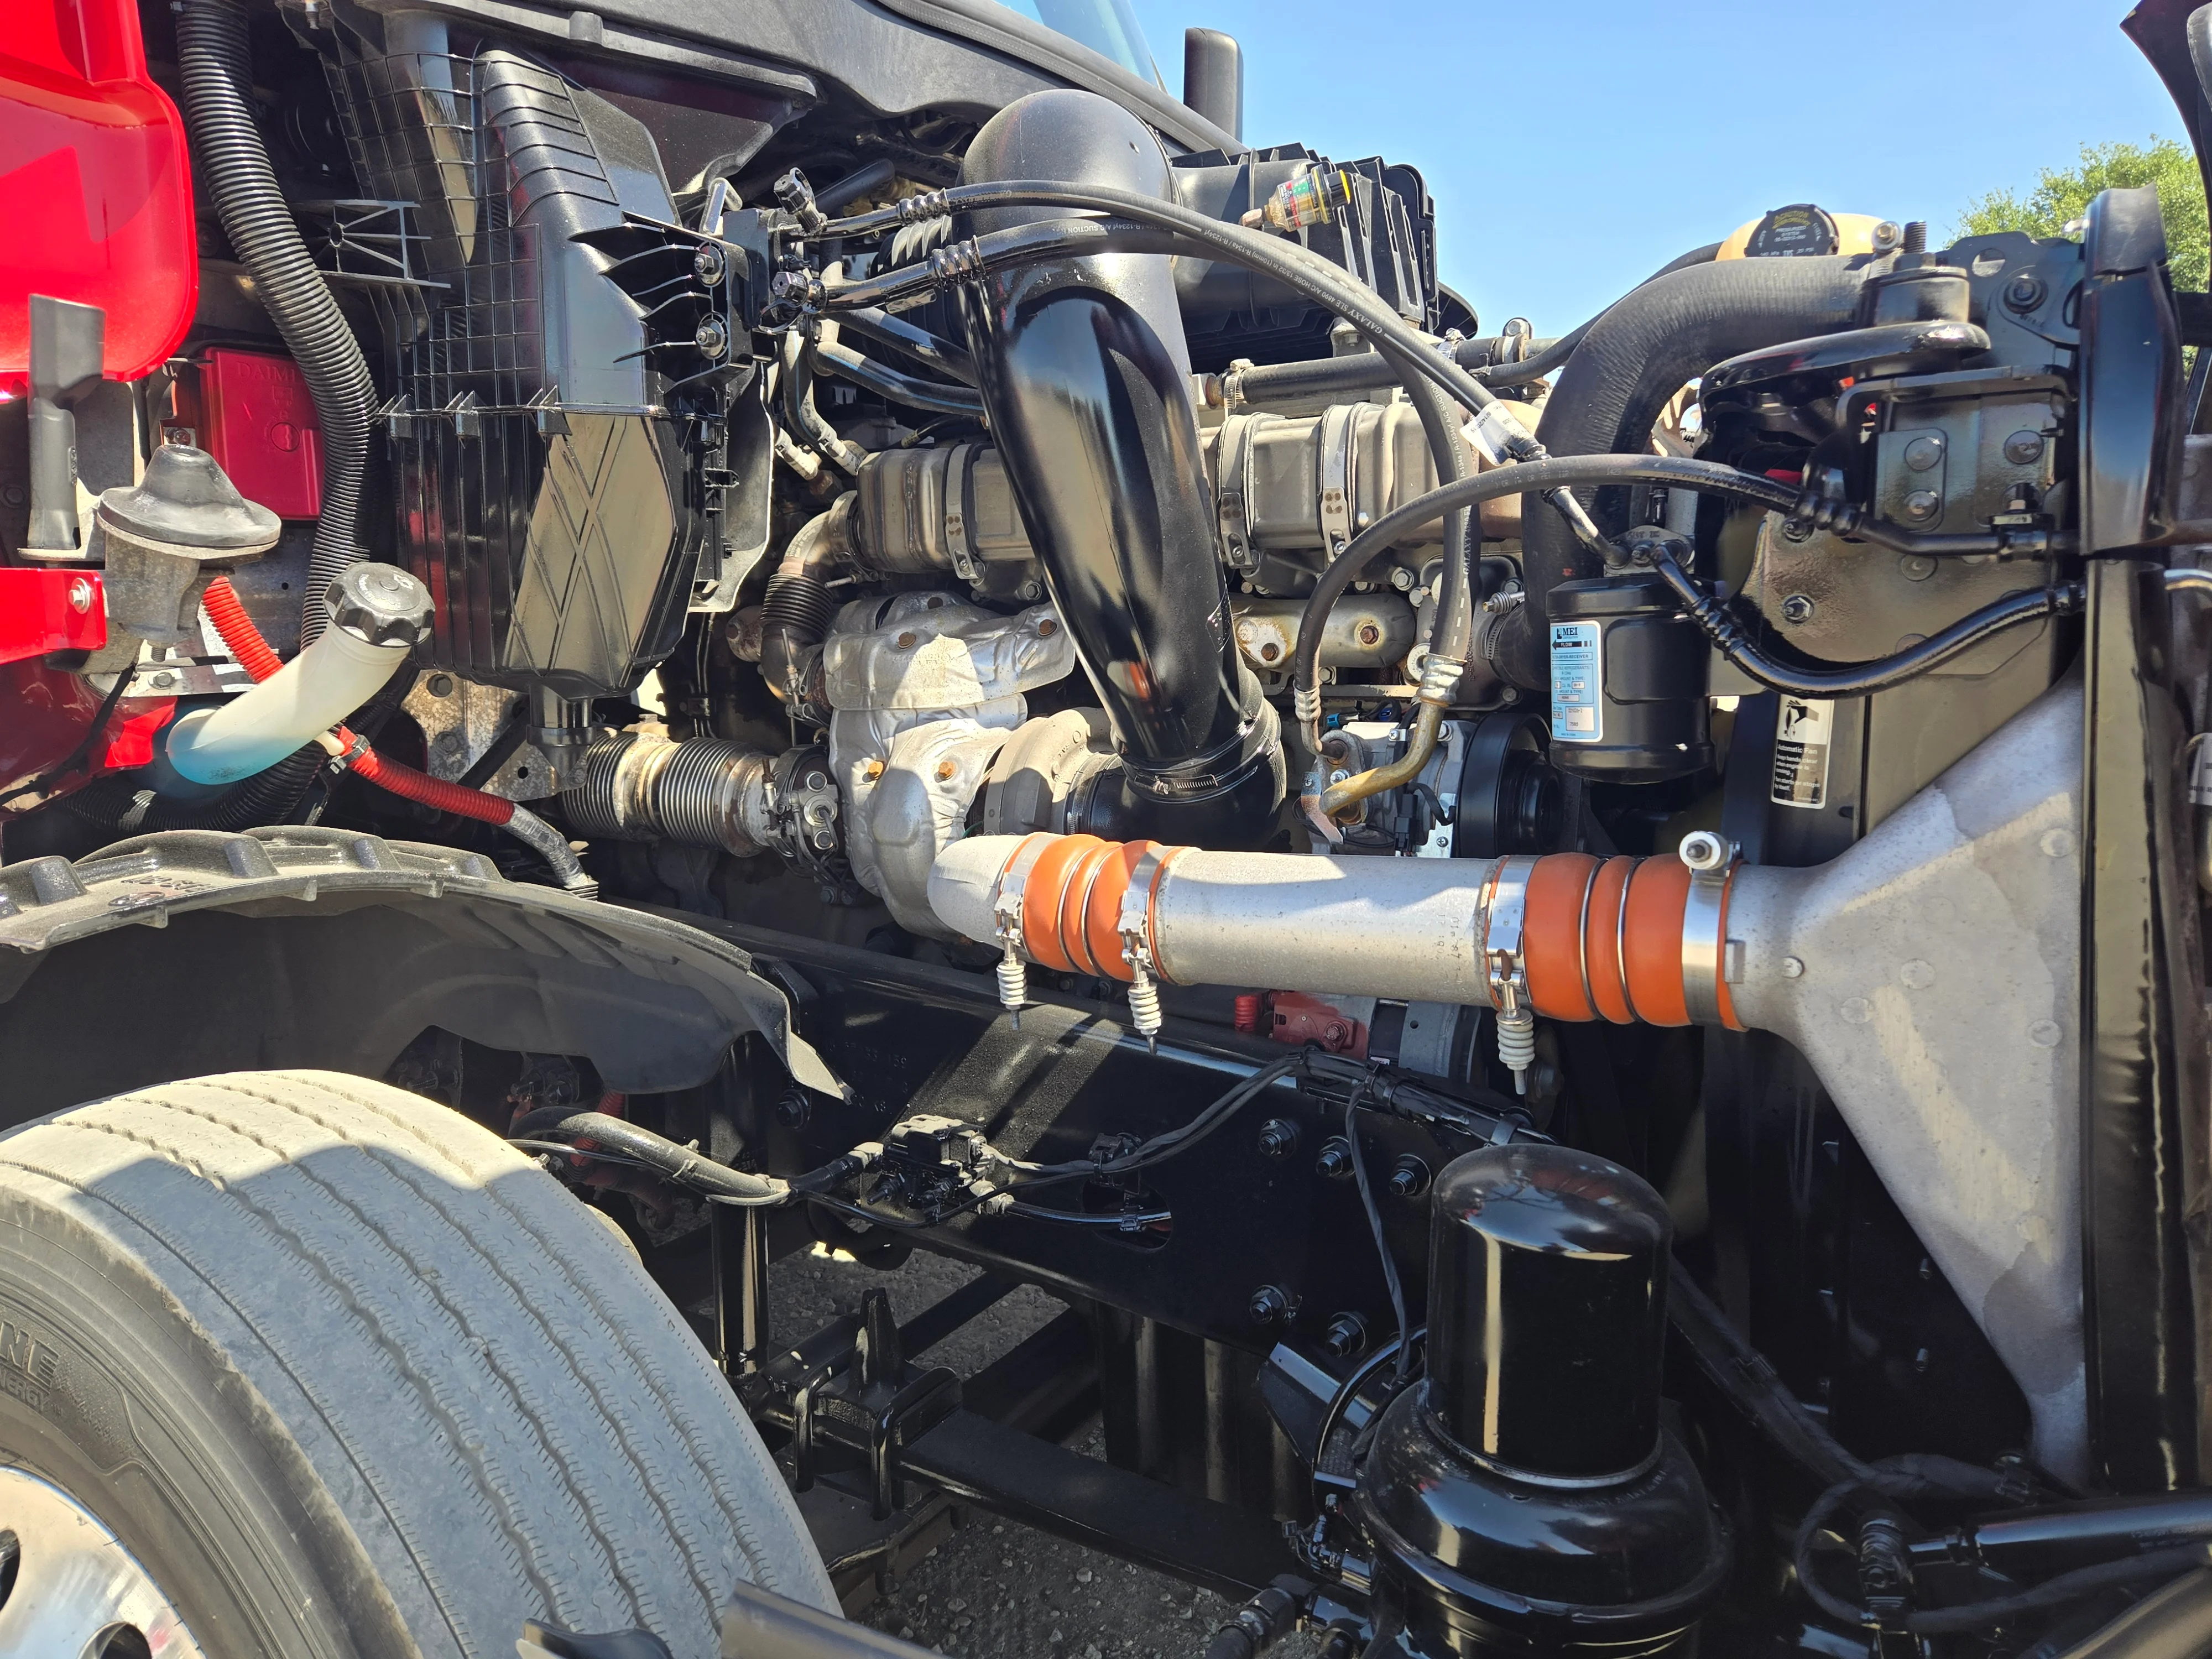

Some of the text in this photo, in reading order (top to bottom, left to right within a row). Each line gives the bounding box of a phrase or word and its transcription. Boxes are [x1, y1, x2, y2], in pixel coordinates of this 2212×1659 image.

[1068, 225, 1099, 234] SUCTION
[1232, 242, 1251, 255] R-134a
[1252, 251, 1272, 266] (10mm)
[1279, 266, 1293, 278] 13/32
[1294, 274, 1311, 288] HOSE
[1311, 284, 1322, 294] A/C
[1321, 291, 1335, 302] 4890
[1335, 300, 1349, 311] SLE
[1347, 309, 1383, 334] GALAXY
[1430, 383, 1447, 411] SUCTION
[1443, 412, 1452, 423] A/C
[1458, 455, 1466, 477] R-134a
[1463, 536, 1472, 575] GALAXY
[1563, 627, 1578, 635] MEI
[0, 1319, 60, 1389] NE
